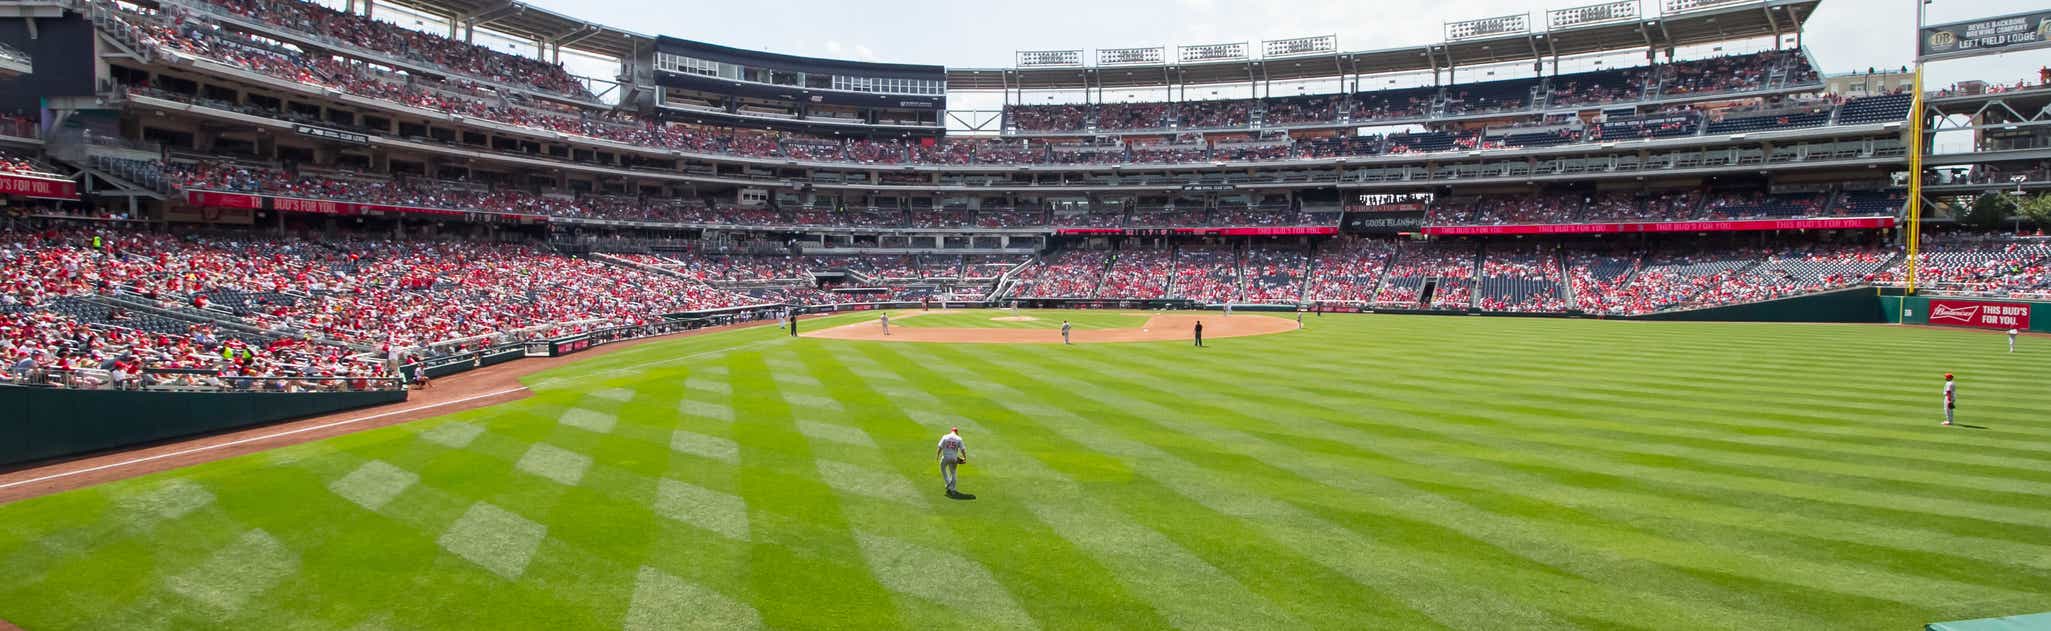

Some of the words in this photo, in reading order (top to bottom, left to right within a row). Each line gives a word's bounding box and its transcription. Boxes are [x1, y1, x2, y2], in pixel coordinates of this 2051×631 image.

[1959, 38, 1979, 49] LEFT
[1981, 35, 2005, 46] FIELD
[2007, 31, 2036, 43] LODGE
[13, 179, 30, 192] FOR
[301, 200, 317, 212] FOR
[1982, 305, 2001, 315] THIS
[2002, 306, 2027, 316] BUD'S
[1981, 315, 1998, 324] FOR
[2000, 316, 2018, 325] YOU.
